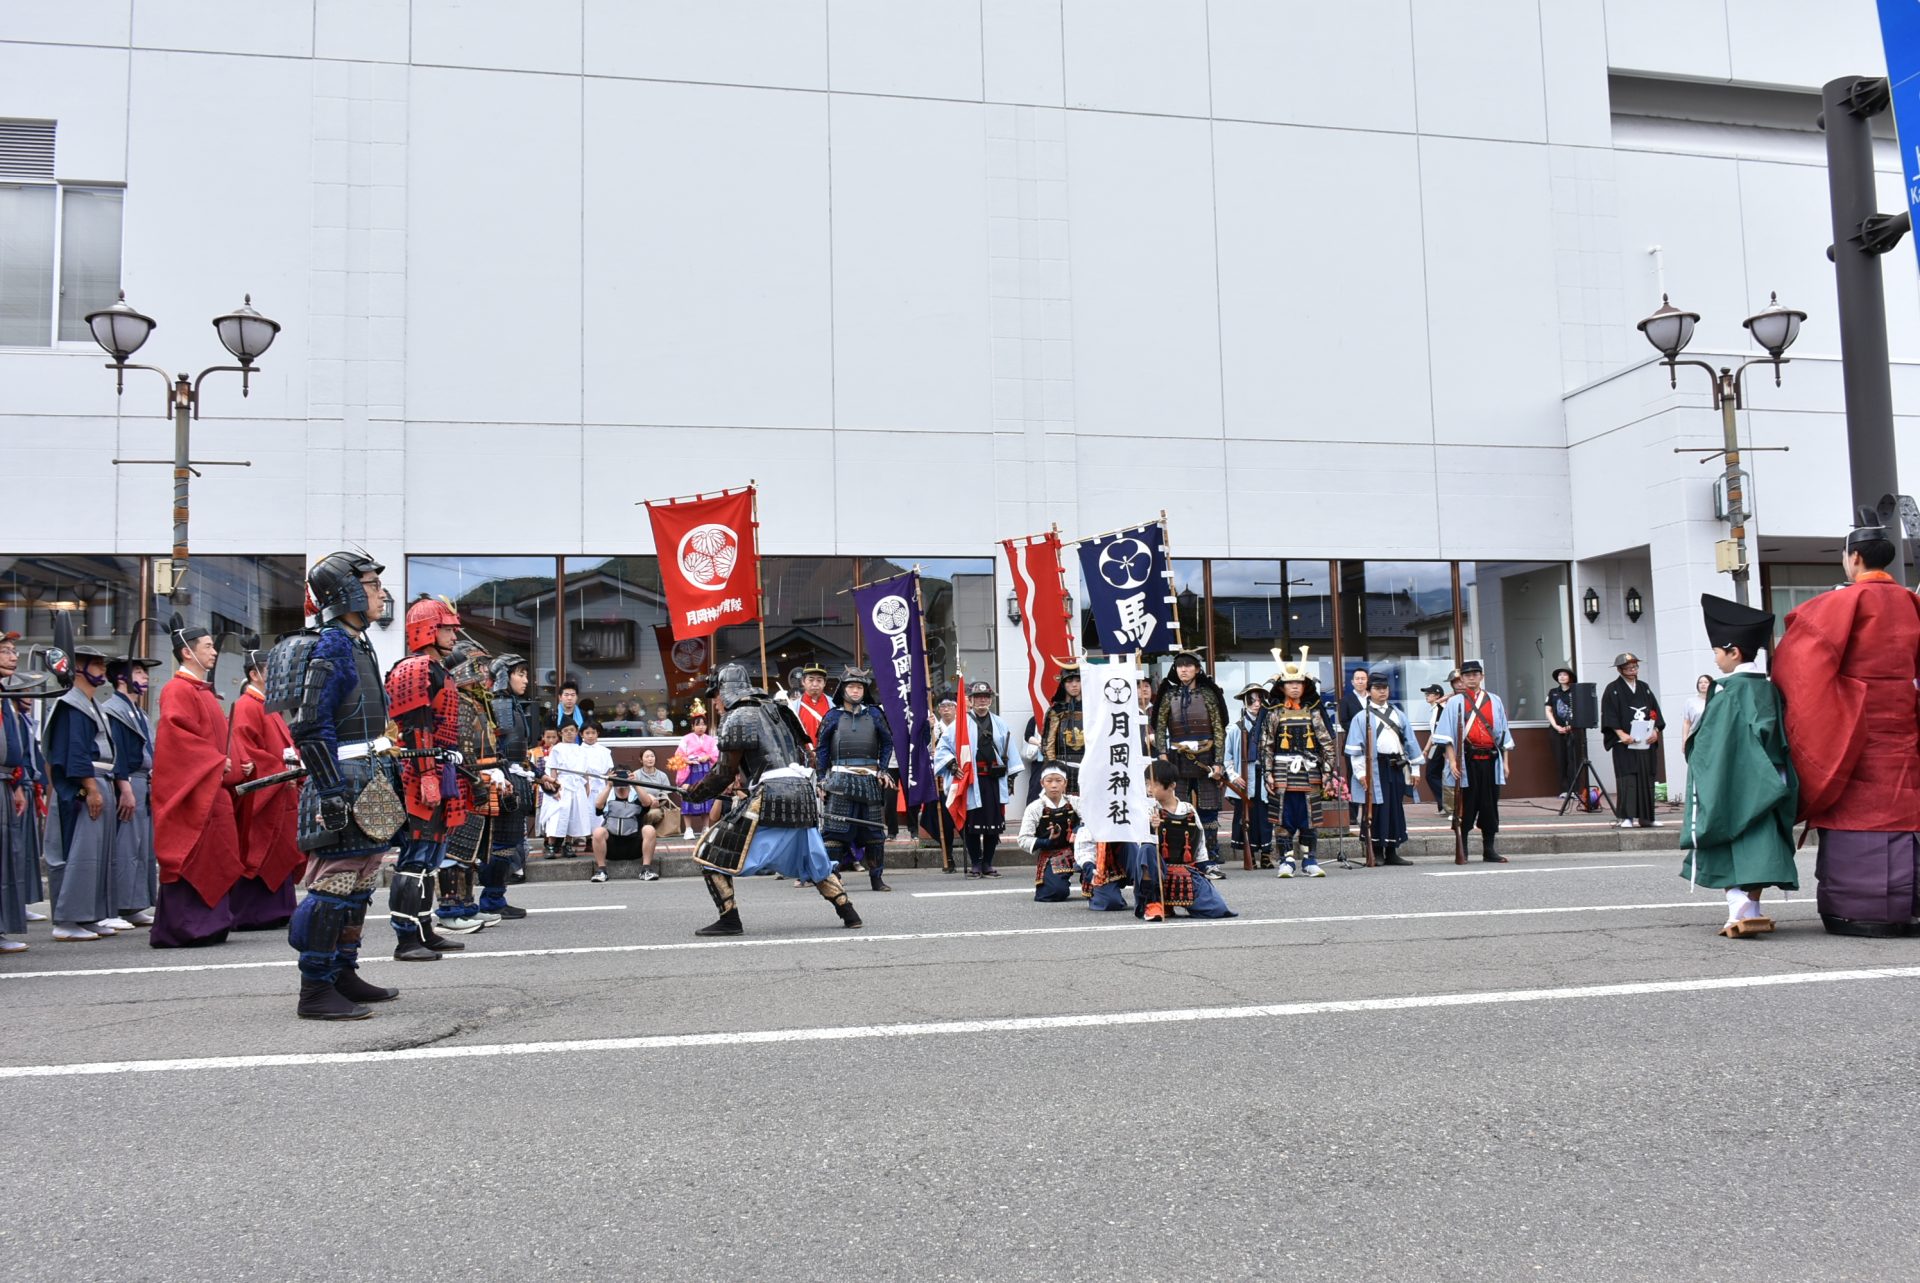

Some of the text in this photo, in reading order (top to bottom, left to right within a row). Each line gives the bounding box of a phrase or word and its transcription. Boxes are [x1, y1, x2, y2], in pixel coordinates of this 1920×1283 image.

[1113, 591, 1158, 648] 馬
[1107, 712, 1131, 825] 月岡神社
